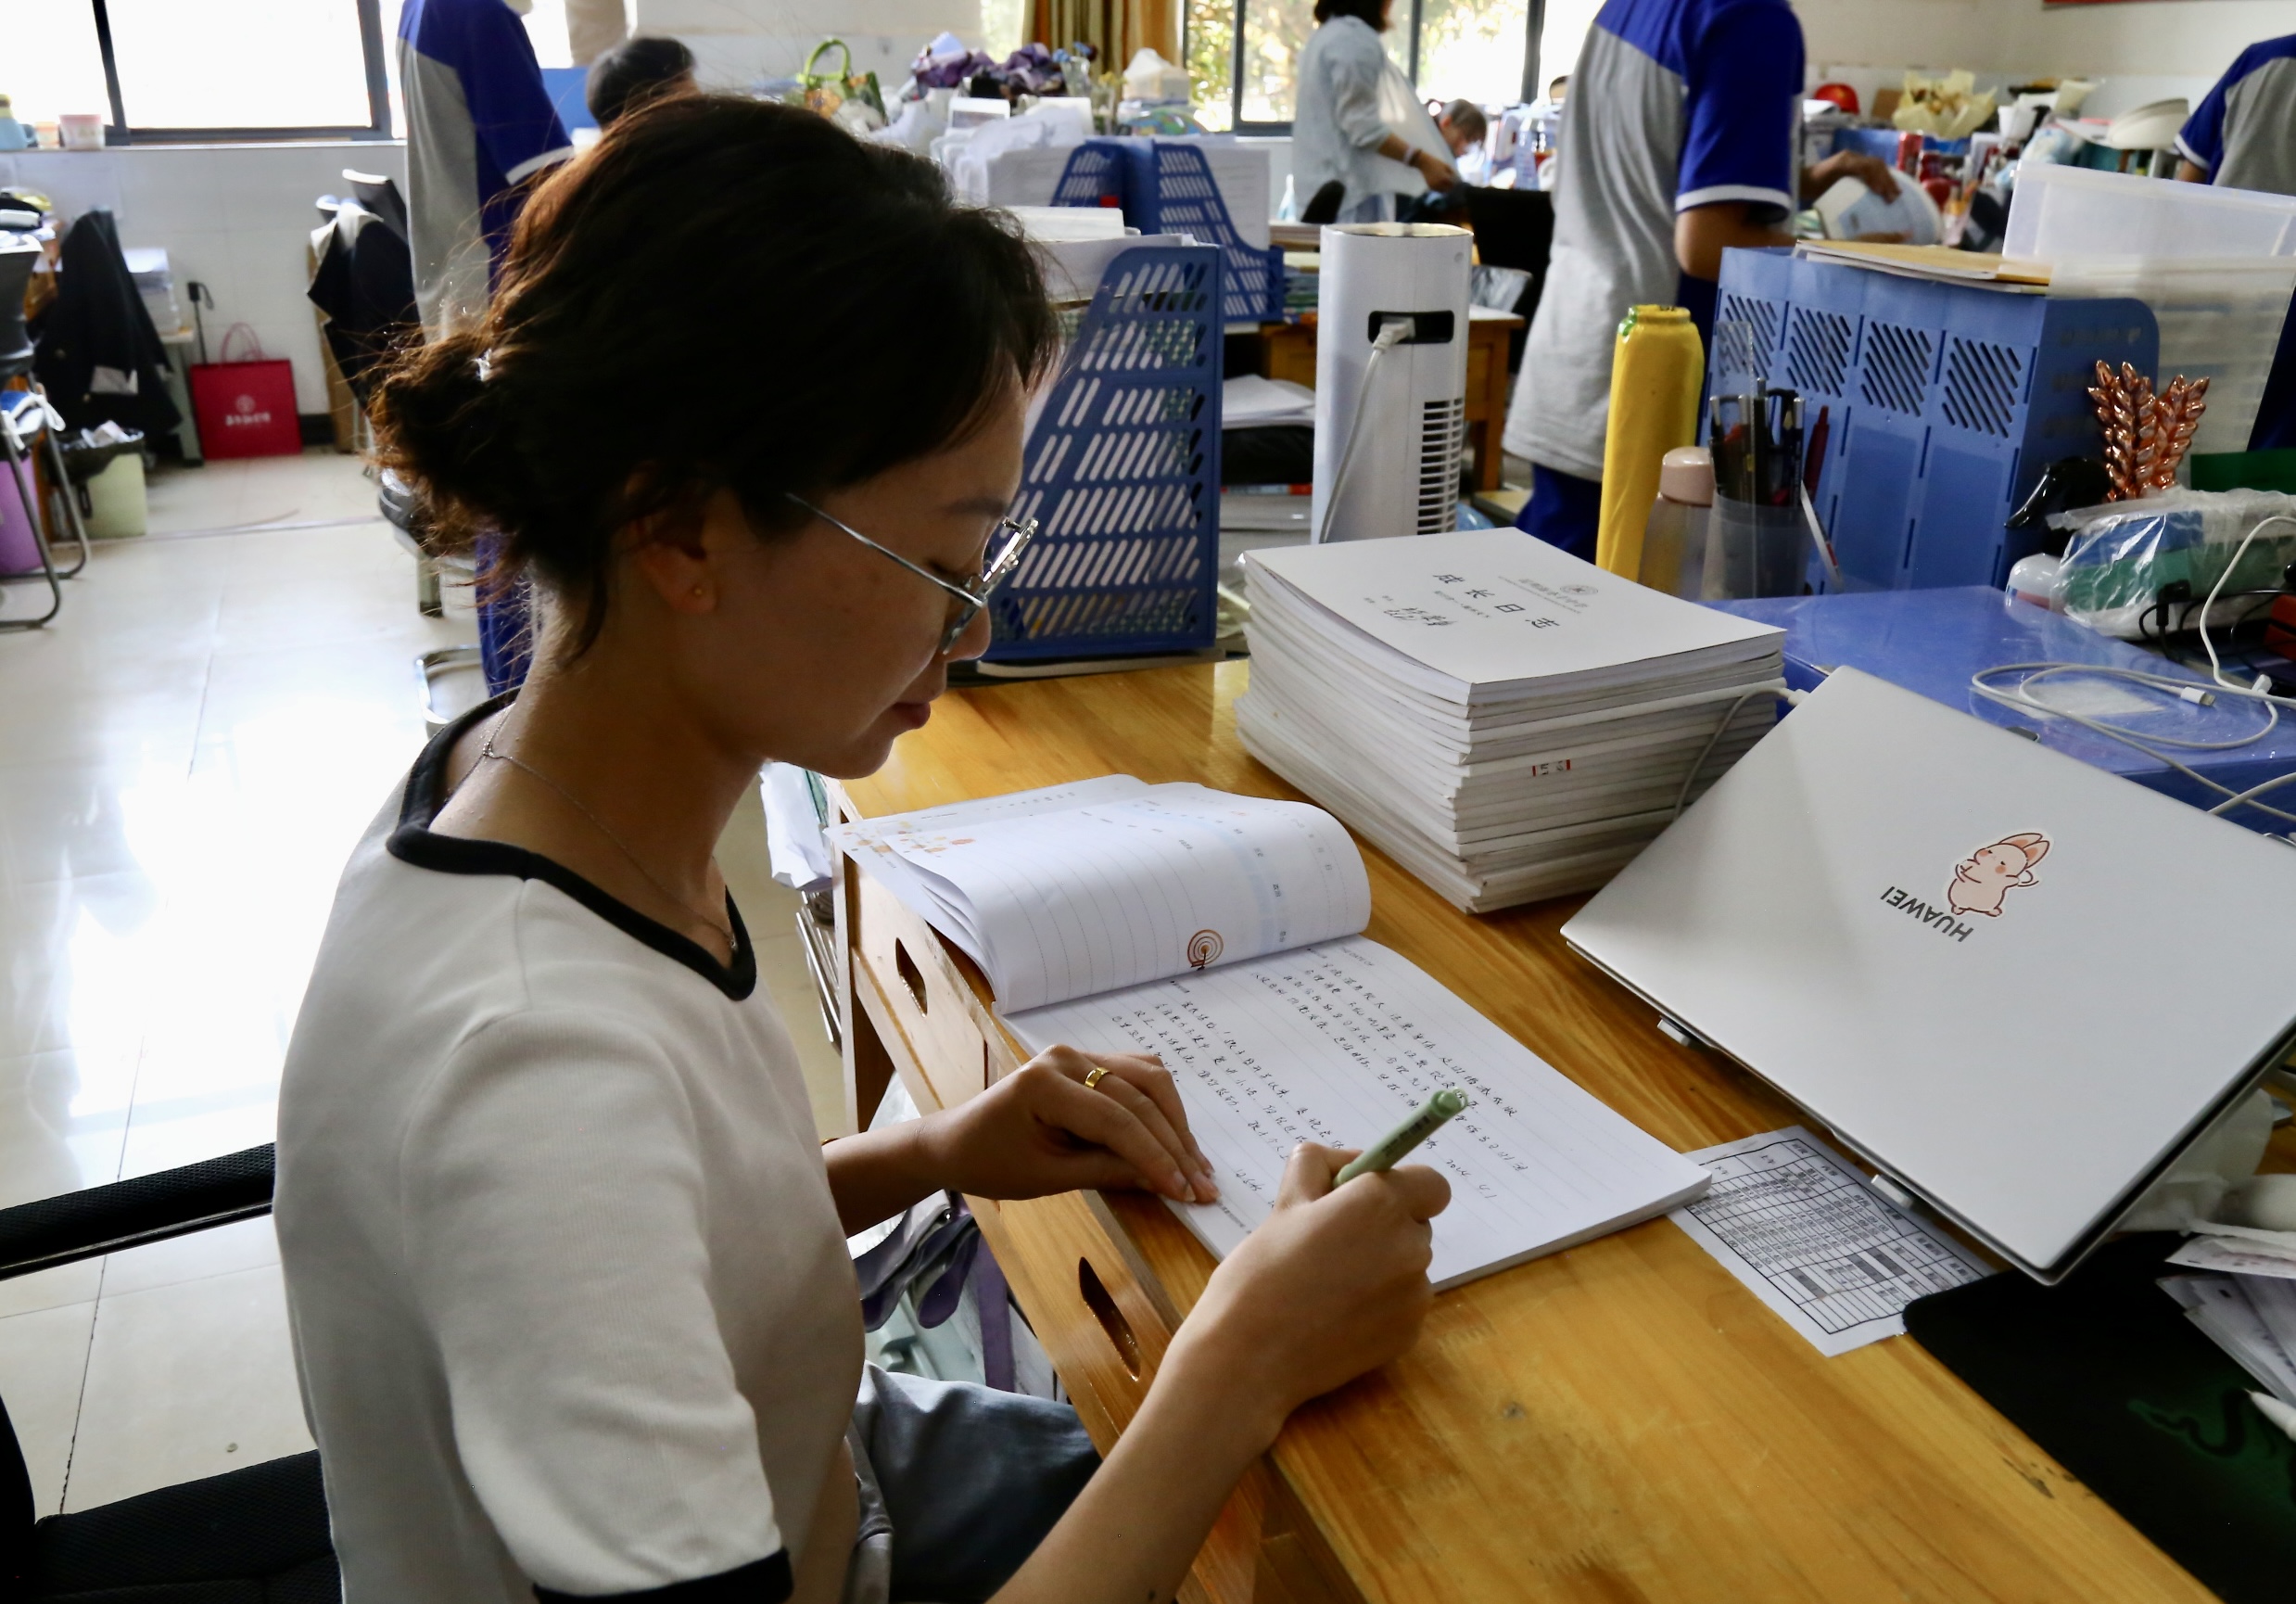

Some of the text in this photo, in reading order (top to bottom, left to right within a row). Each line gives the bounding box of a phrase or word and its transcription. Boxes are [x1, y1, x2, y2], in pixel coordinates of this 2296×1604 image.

[1433, 573, 1561, 629] 成长日志
[1880, 886, 1974, 942] HUAWEI
